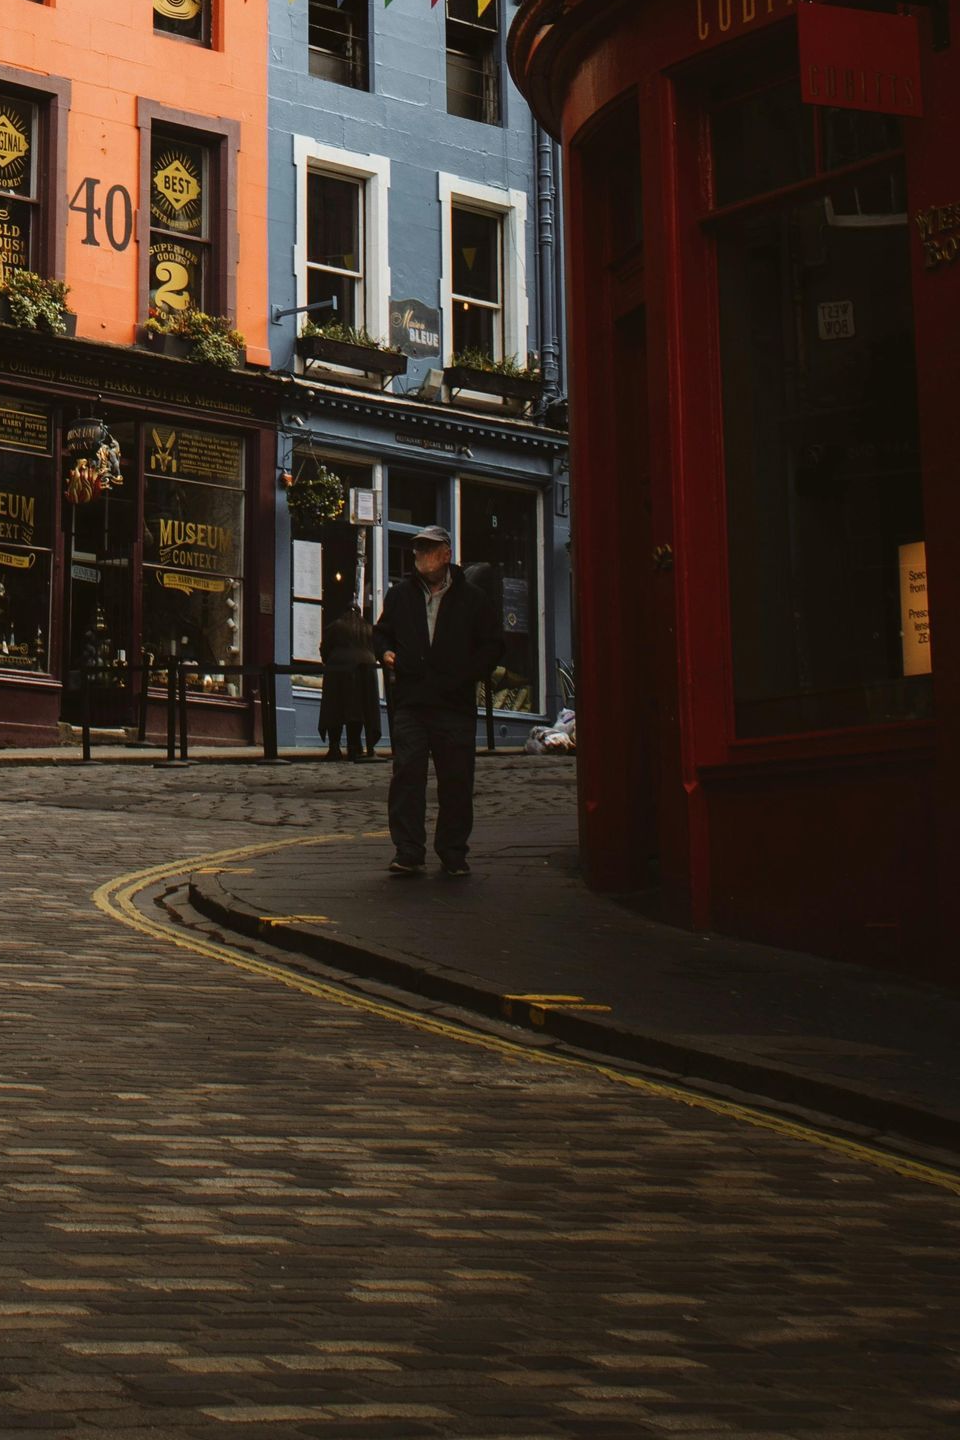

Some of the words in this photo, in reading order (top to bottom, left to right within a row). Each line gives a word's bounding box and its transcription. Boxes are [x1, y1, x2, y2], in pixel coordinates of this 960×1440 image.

[808, 63, 915, 109] CUBITTS
[163, 175, 191, 195] BEST
[69, 176, 133, 252] 40
[148, 243, 198, 265] SUPERIOR
[155, 261, 190, 310] 2
[409, 327, 439, 348] BLEUE
[104, 377, 142, 396] HARRY
[145, 383, 192, 404] POTTER
[2, 418, 23, 428] HARRY
[24, 422, 47, 433] POTTER
[160, 518, 233, 554] MUSEUM
[172, 549, 218, 570] CONTEXT
[909, 570, 927, 582] Spec
[909, 583, 926, 594] from
[909, 608, 930, 620] Presc
[918, 632, 929, 645] ZE
